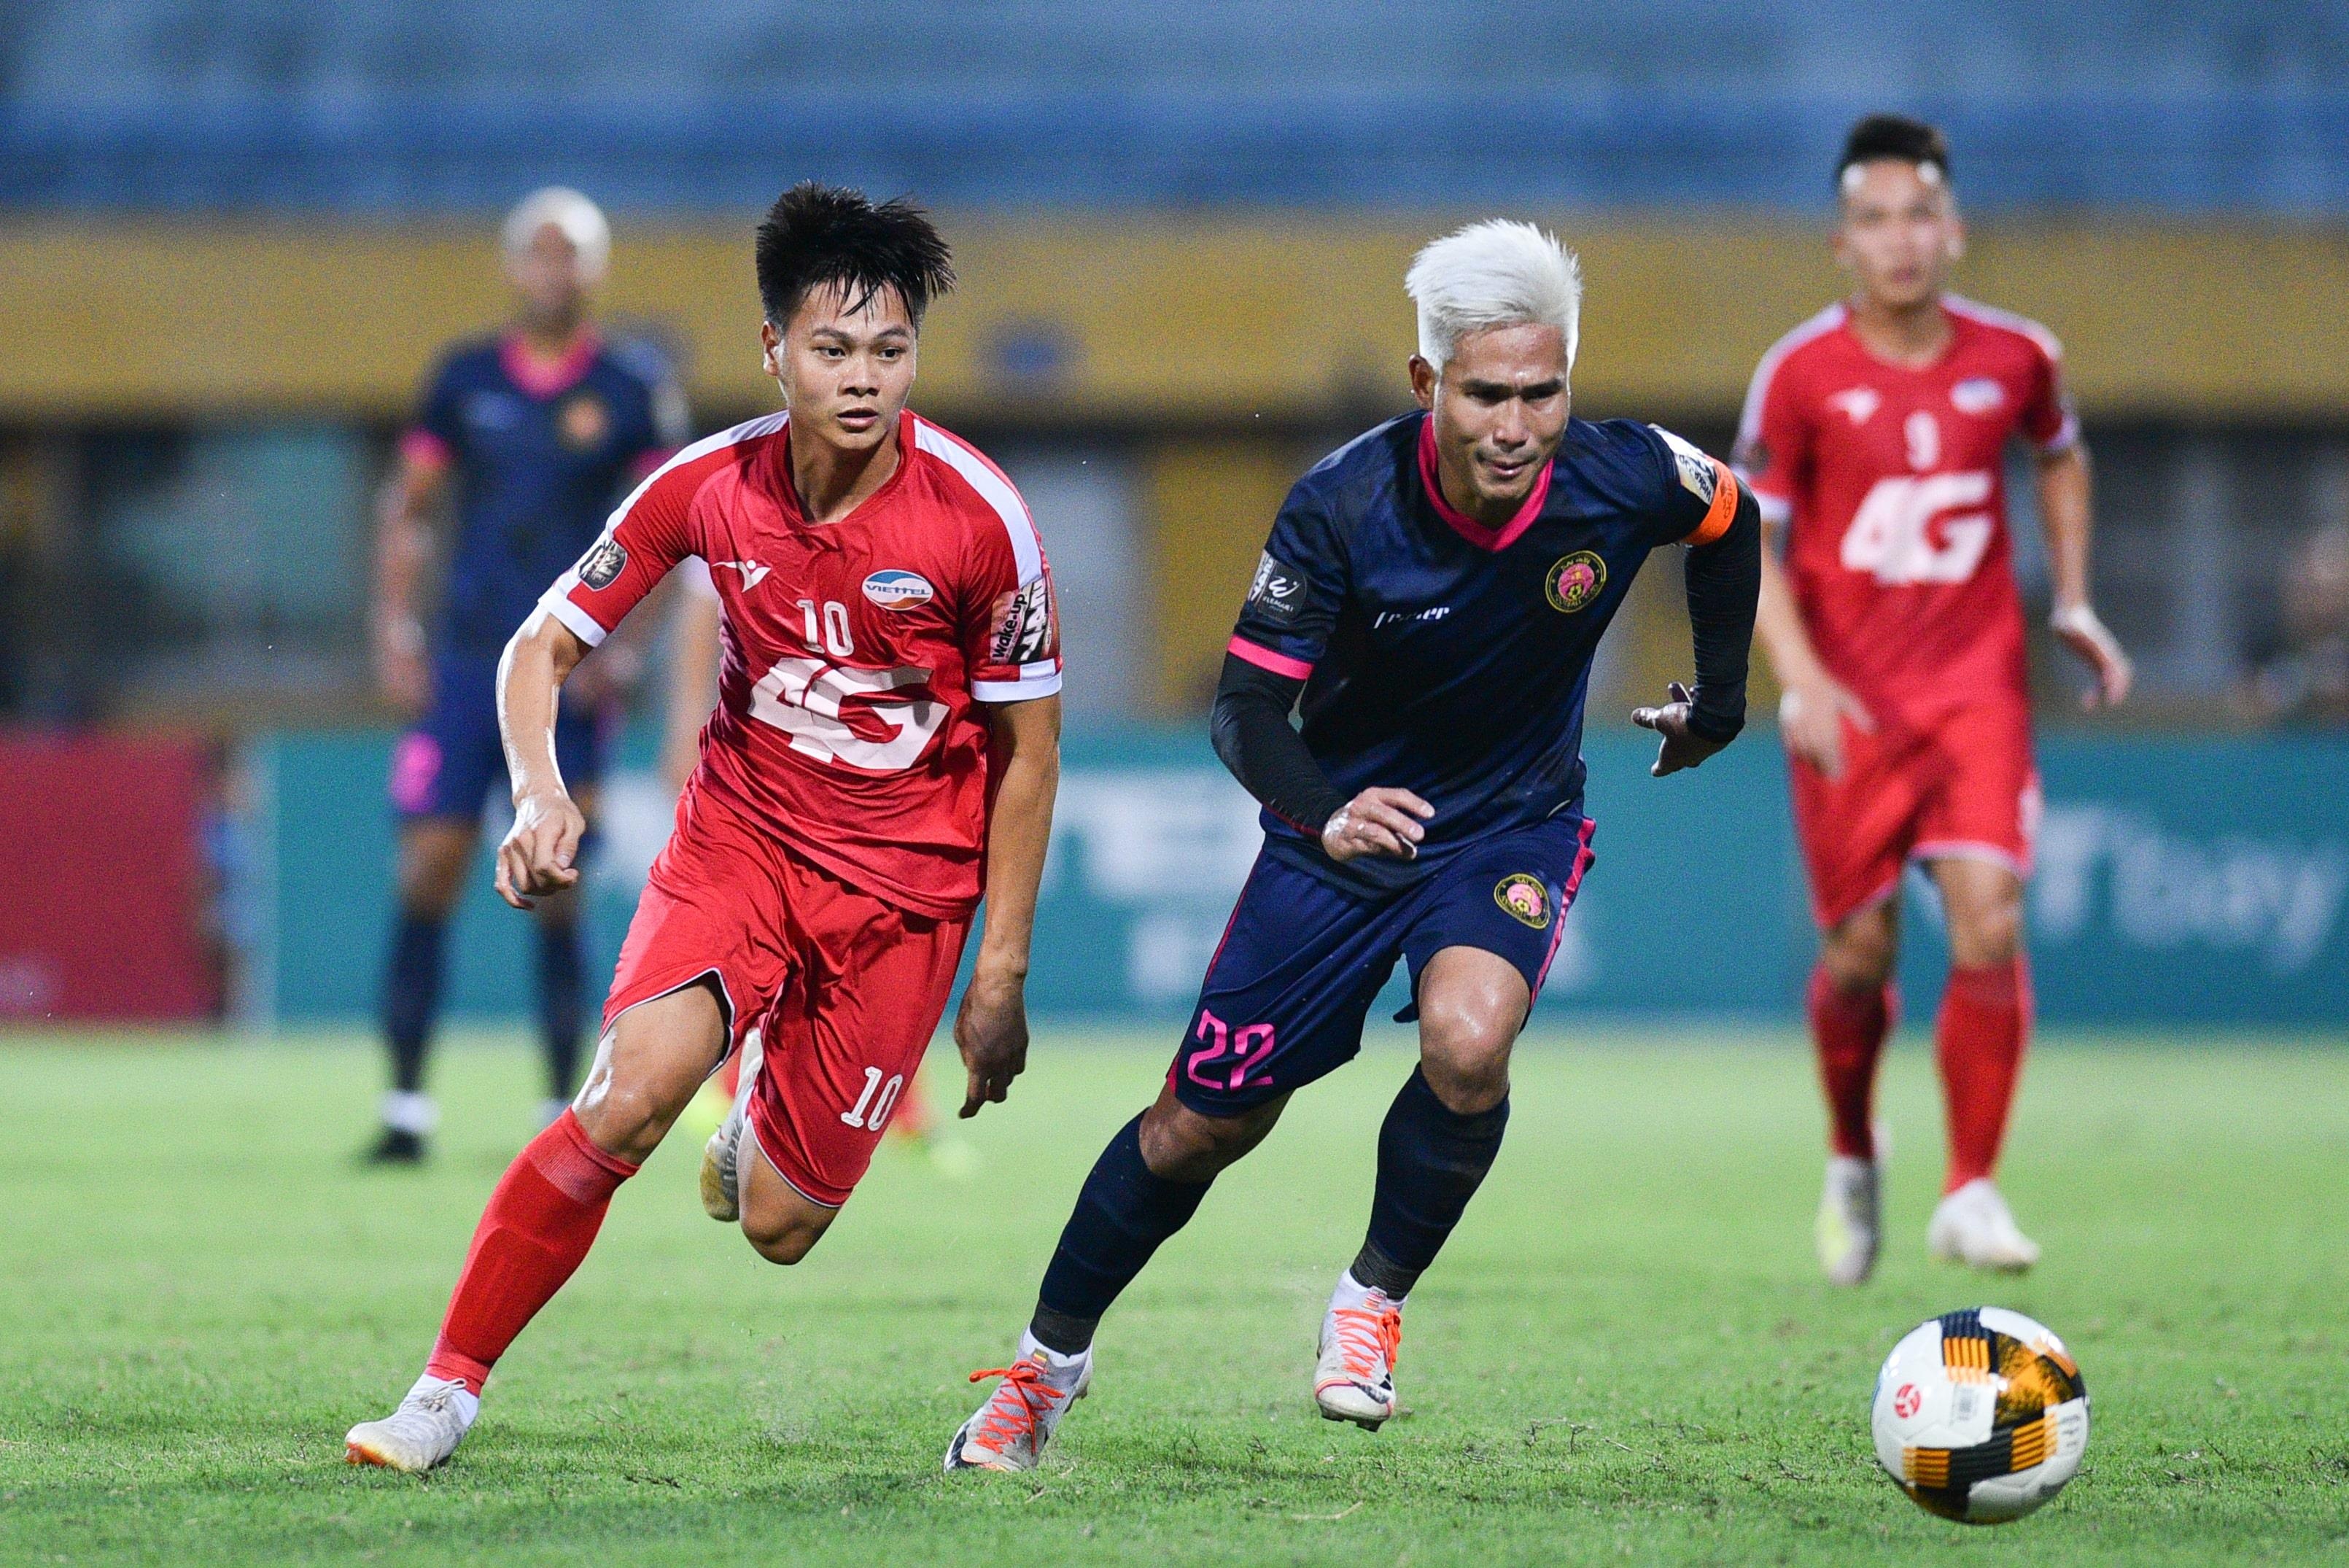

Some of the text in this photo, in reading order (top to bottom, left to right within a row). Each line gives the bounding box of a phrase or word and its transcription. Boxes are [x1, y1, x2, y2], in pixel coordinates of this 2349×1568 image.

[1840, 473, 1992, 586] 4G
[865, 584, 931, 595] VIETTEL
[796, 599, 855, 656] 10
[993, 594, 1028, 658] Wake-up
[747, 656, 950, 769] 4G
[1187, 1009, 1275, 1090] 22
[841, 1066, 904, 1131] 10
